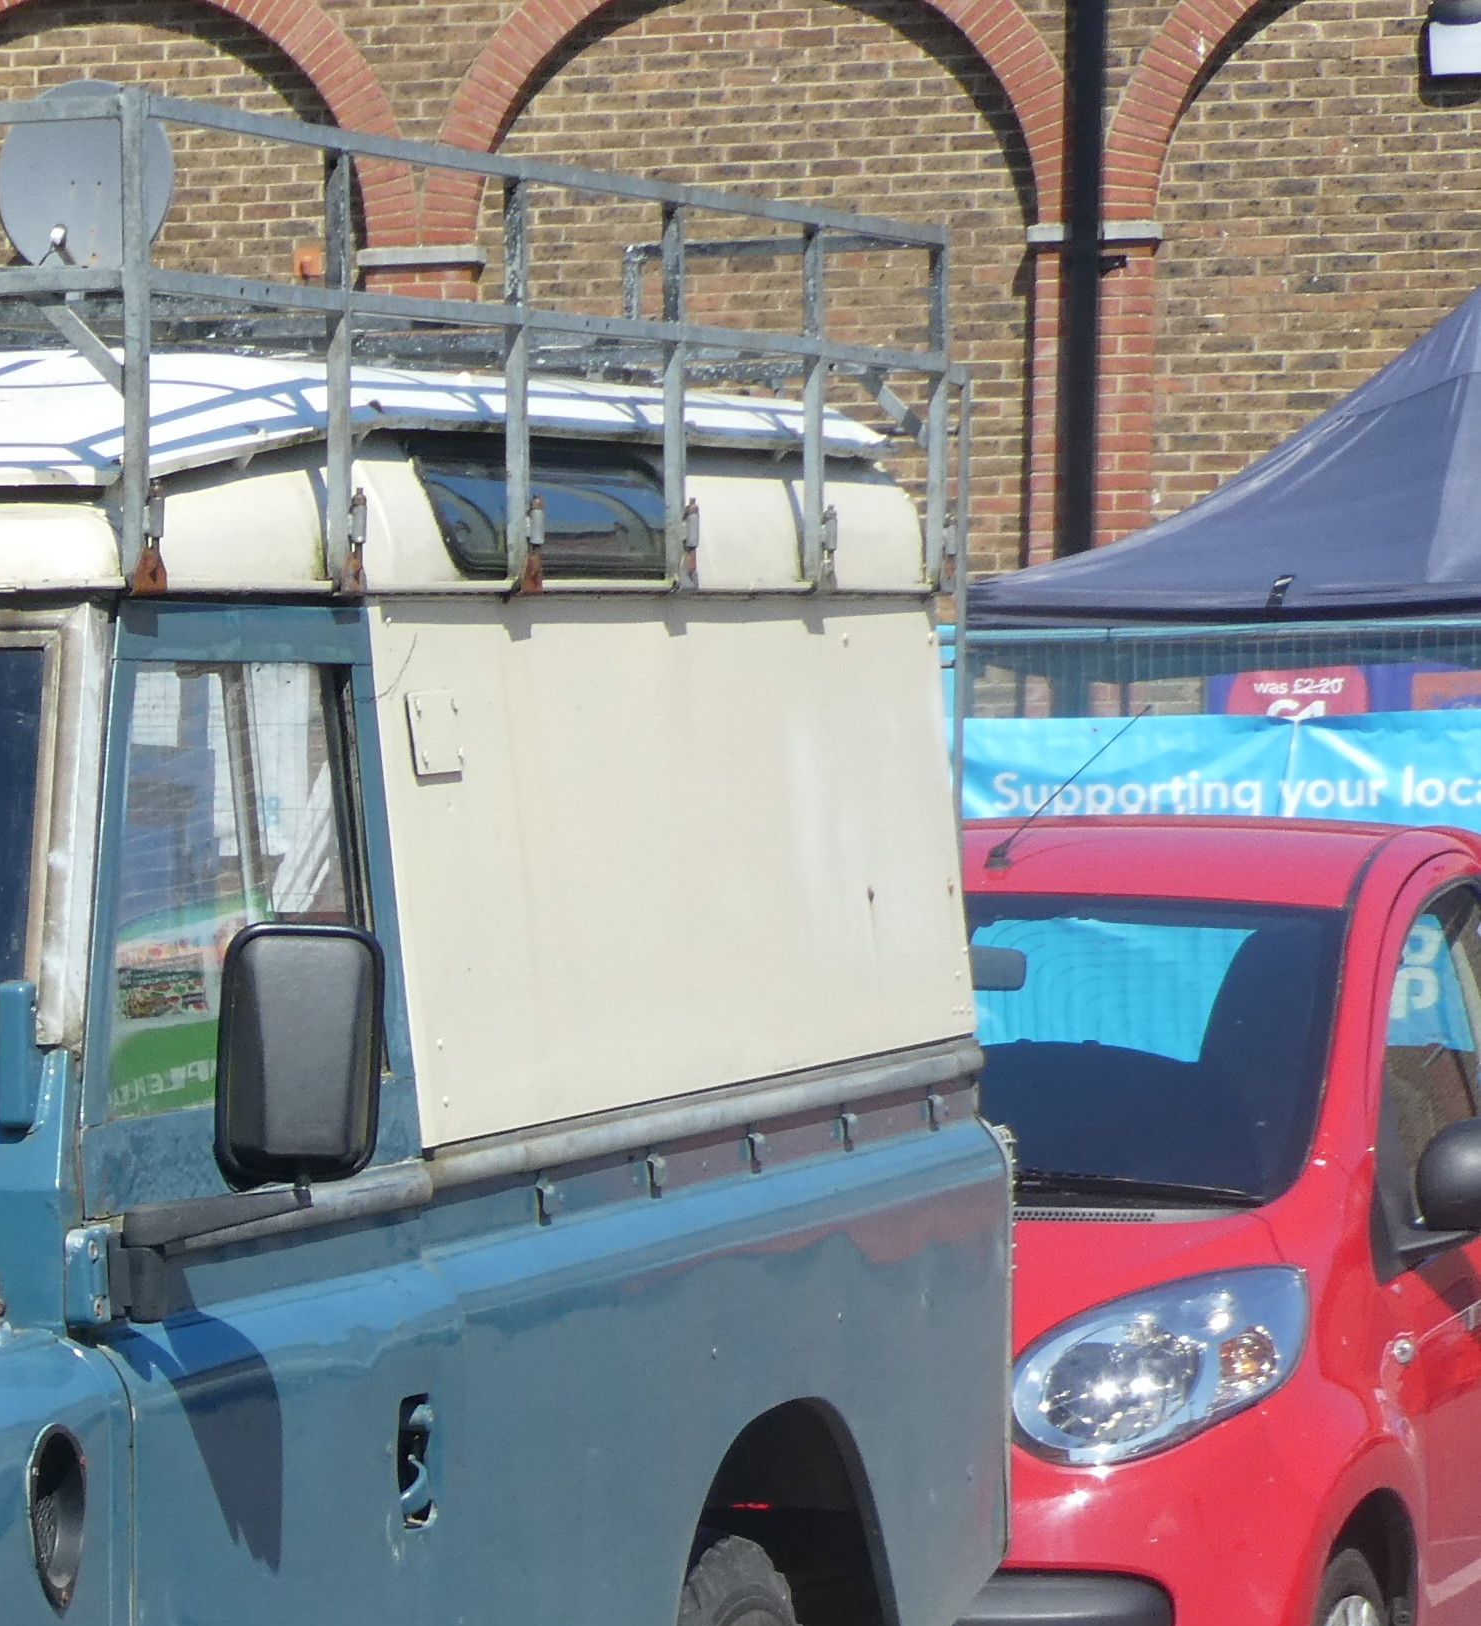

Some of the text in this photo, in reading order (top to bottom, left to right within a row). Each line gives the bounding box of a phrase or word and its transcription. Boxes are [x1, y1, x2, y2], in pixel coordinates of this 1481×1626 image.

[1254, 677, 1345, 695] was £2.20
[993, 765, 1481, 818] Supporting your loc
